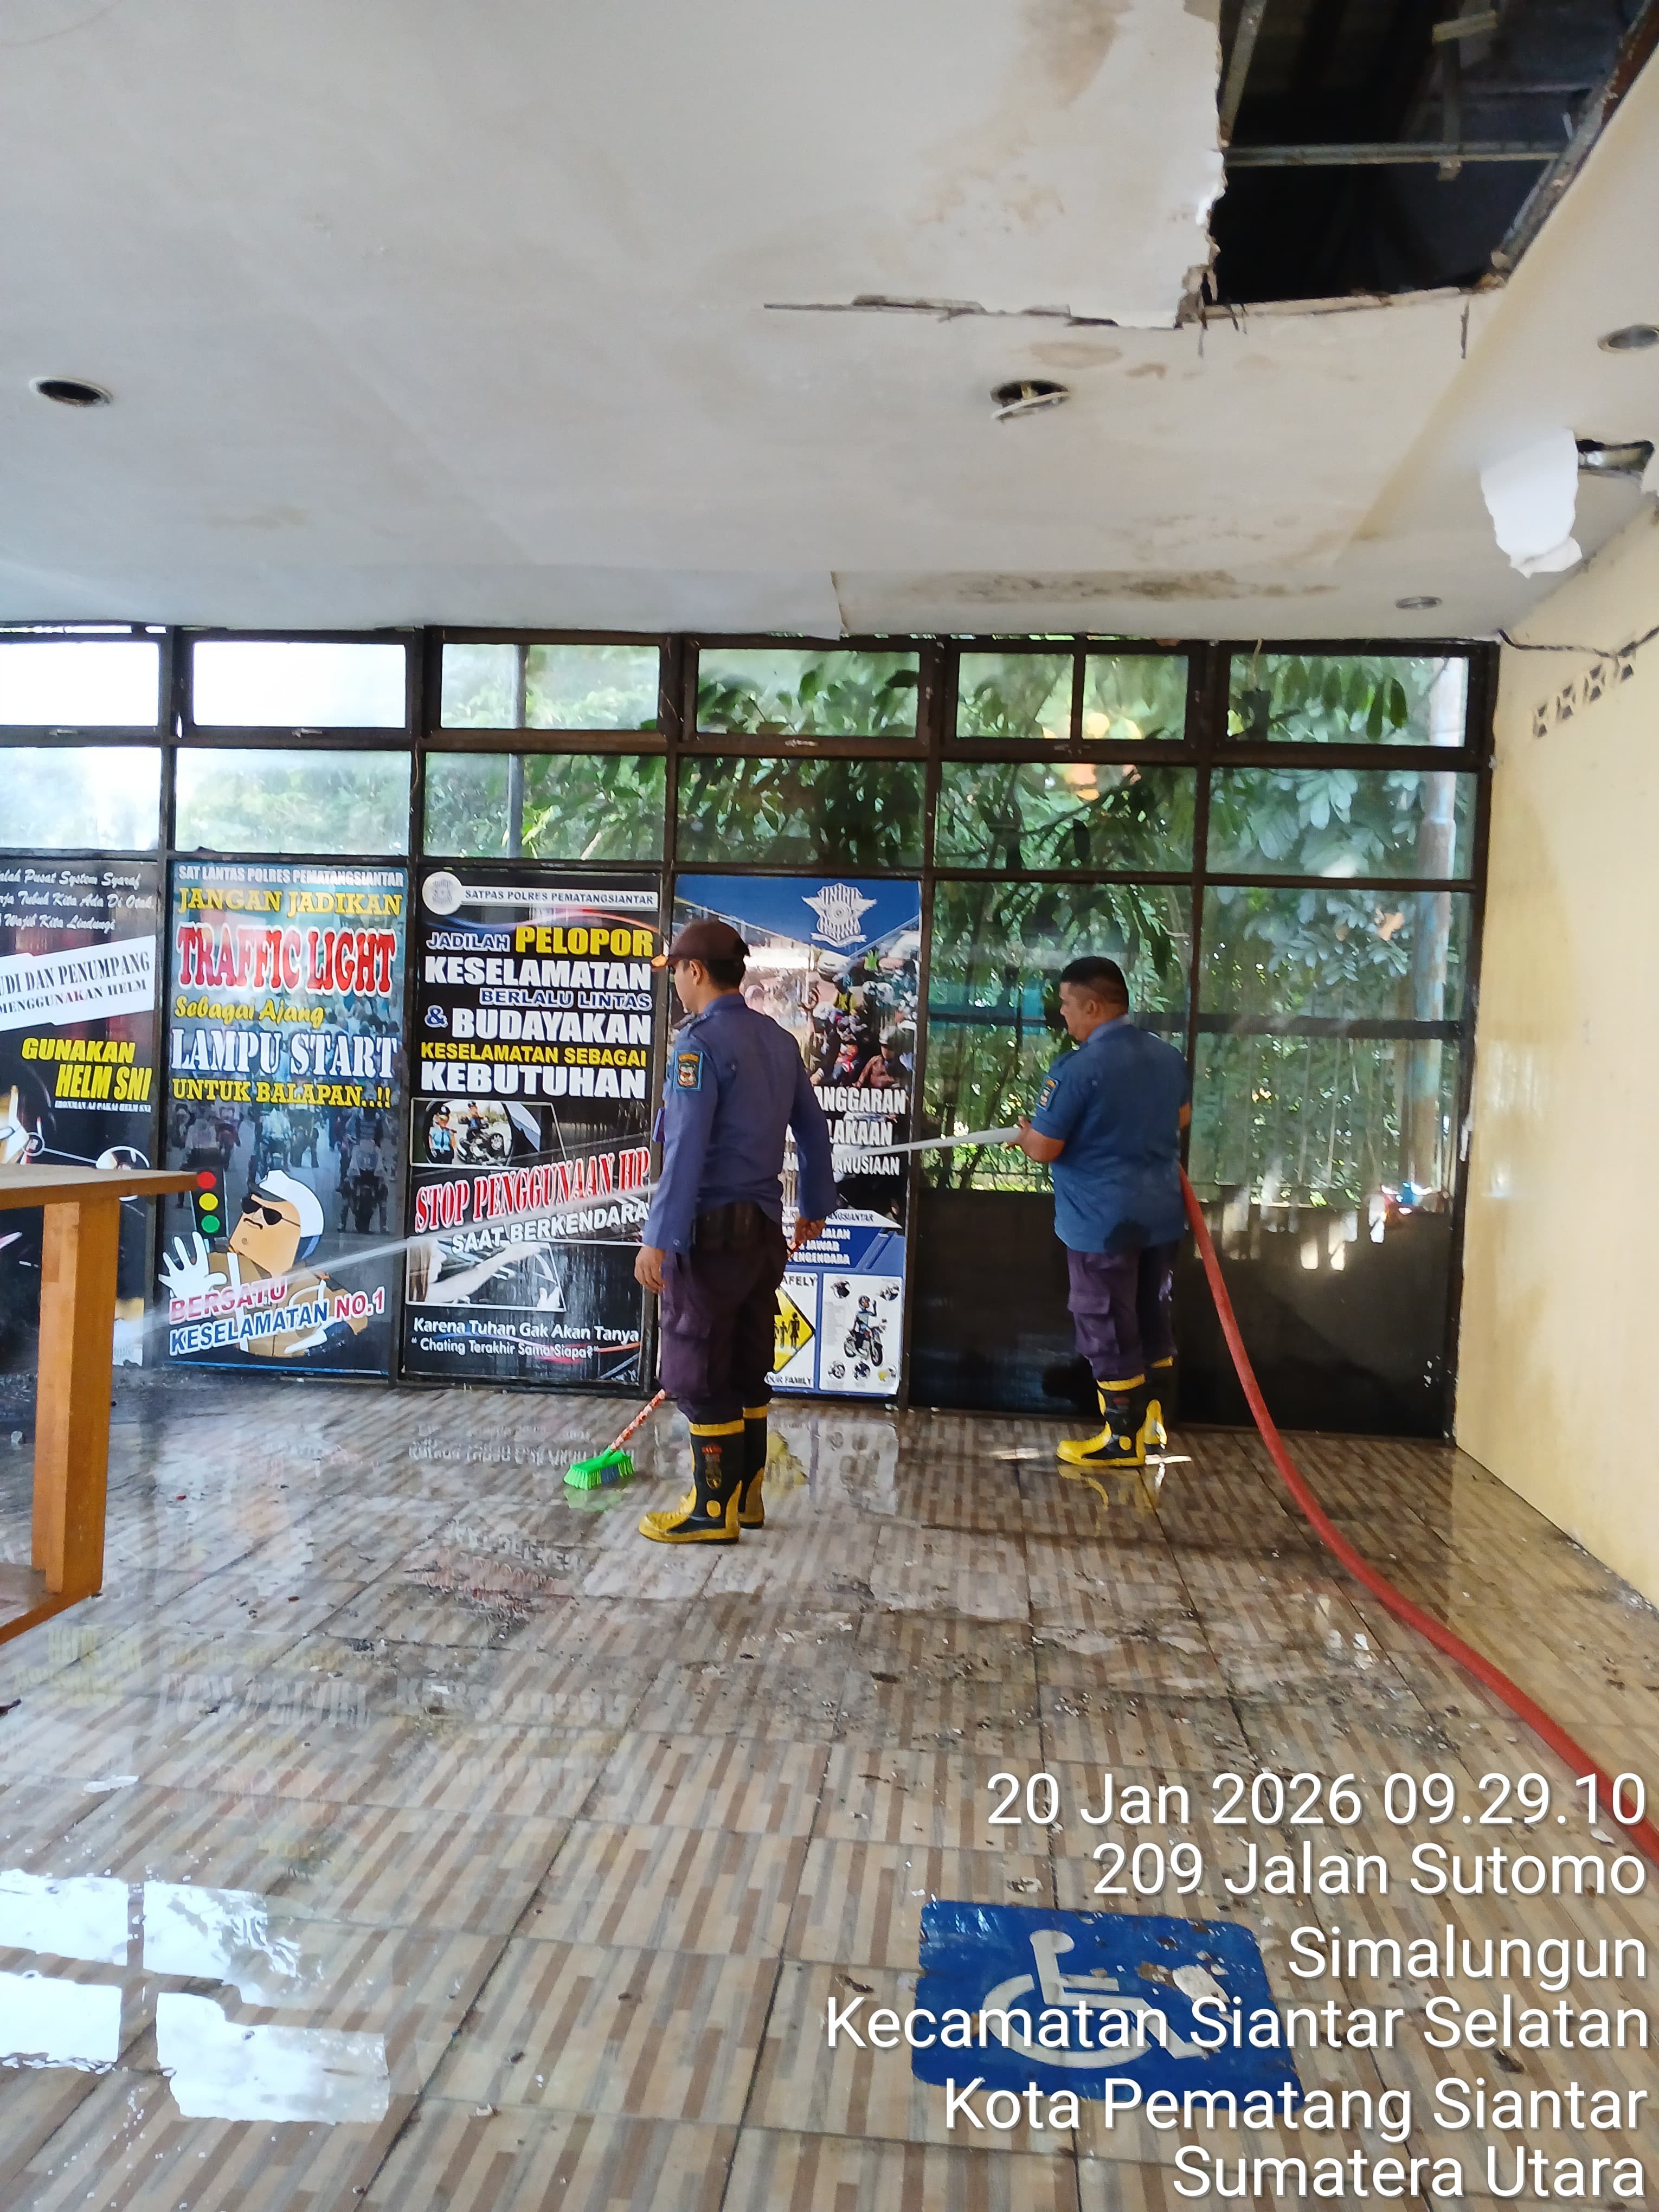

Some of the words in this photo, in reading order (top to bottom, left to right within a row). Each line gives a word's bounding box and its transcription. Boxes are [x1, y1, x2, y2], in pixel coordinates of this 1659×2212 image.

[59, 871, 98, 888] System
[101, 872, 141, 890] Syaraf
[179, 866, 200, 880] SAT
[202, 866, 245, 882] LANTAS
[248, 869, 291, 884] POLRES
[293, 870, 404, 888] PEMATANGSIANTAR
[53, 892, 77, 906] Kita
[80, 893, 104, 907] Ada
[107, 894, 123, 908] Di
[179, 888, 282, 912] JANGAN
[287, 892, 402, 918] JADIKAN
[465, 890, 504, 899] SATPAS
[507, 892, 548, 901] POLRES
[551, 893, 653, 904] PEMATANGSIANTAR
[39, 914, 63, 928] Kita
[67, 915, 115, 934] Lindungi
[426, 932, 510, 951] JADILAH
[516, 926, 653, 957] PELOPOR
[25, 967, 54, 991] DAN
[58, 951, 150, 985] PENUMPANG
[176, 922, 303, 993] TRAFFIC
[305, 927, 397, 998] LIGHT
[425, 956, 651, 991] KESELAMATAN
[108, 979, 146, 995] HELM
[479, 988, 574, 1008] BERLALU
[577, 992, 652, 1011] LINTAS
[174, 995, 255, 1024] Sebagai
[259, 999, 325, 1028] Ajang
[425, 1005, 448, 1028] &
[452, 1007, 651, 1045] BUDAYAKAN
[22, 1038, 136, 1063] GUNAKAN
[171, 1029, 281, 1073] LAMPU
[291, 1032, 397, 1078] START
[421, 1042, 558, 1064] KESELAMATAN
[564, 1048, 646, 1067] SEBAGAI
[55, 1065, 112, 1100] HELM
[114, 1068, 152, 1102] SNI
[172, 1078, 251, 1101] UNTUK
[421, 1061, 646, 1099] KEBUTUHAN
[831, 1155, 900, 1175] ANUSIAAN
[415, 1179, 470, 1233] STOP
[472, 1156, 615, 1222] PENGGUNAAN
[618, 1146, 651, 1191] HP
[452, 1226, 504, 1254] SAAT
[510, 1203, 648, 1244] BERKENDARA
[783, 1275, 816, 1287] AFELY
[169, 1278, 288, 1324] BERSATU
[170, 1300, 330, 1355] KESELAMATAN
[333, 1287, 385, 1323] NO.1
[414, 1317, 466, 1333] Karena
[468, 1320, 516, 1336] Tuhan
[519, 1323, 548, 1338] Gak
[551, 1323, 591, 1340] Akan
[594, 1326, 639, 1345] Tanya
[420, 1338, 466, 1355] Chating
[469, 1340, 515, 1355] Terakhir
[518, 1343, 551, 1356] Sama
